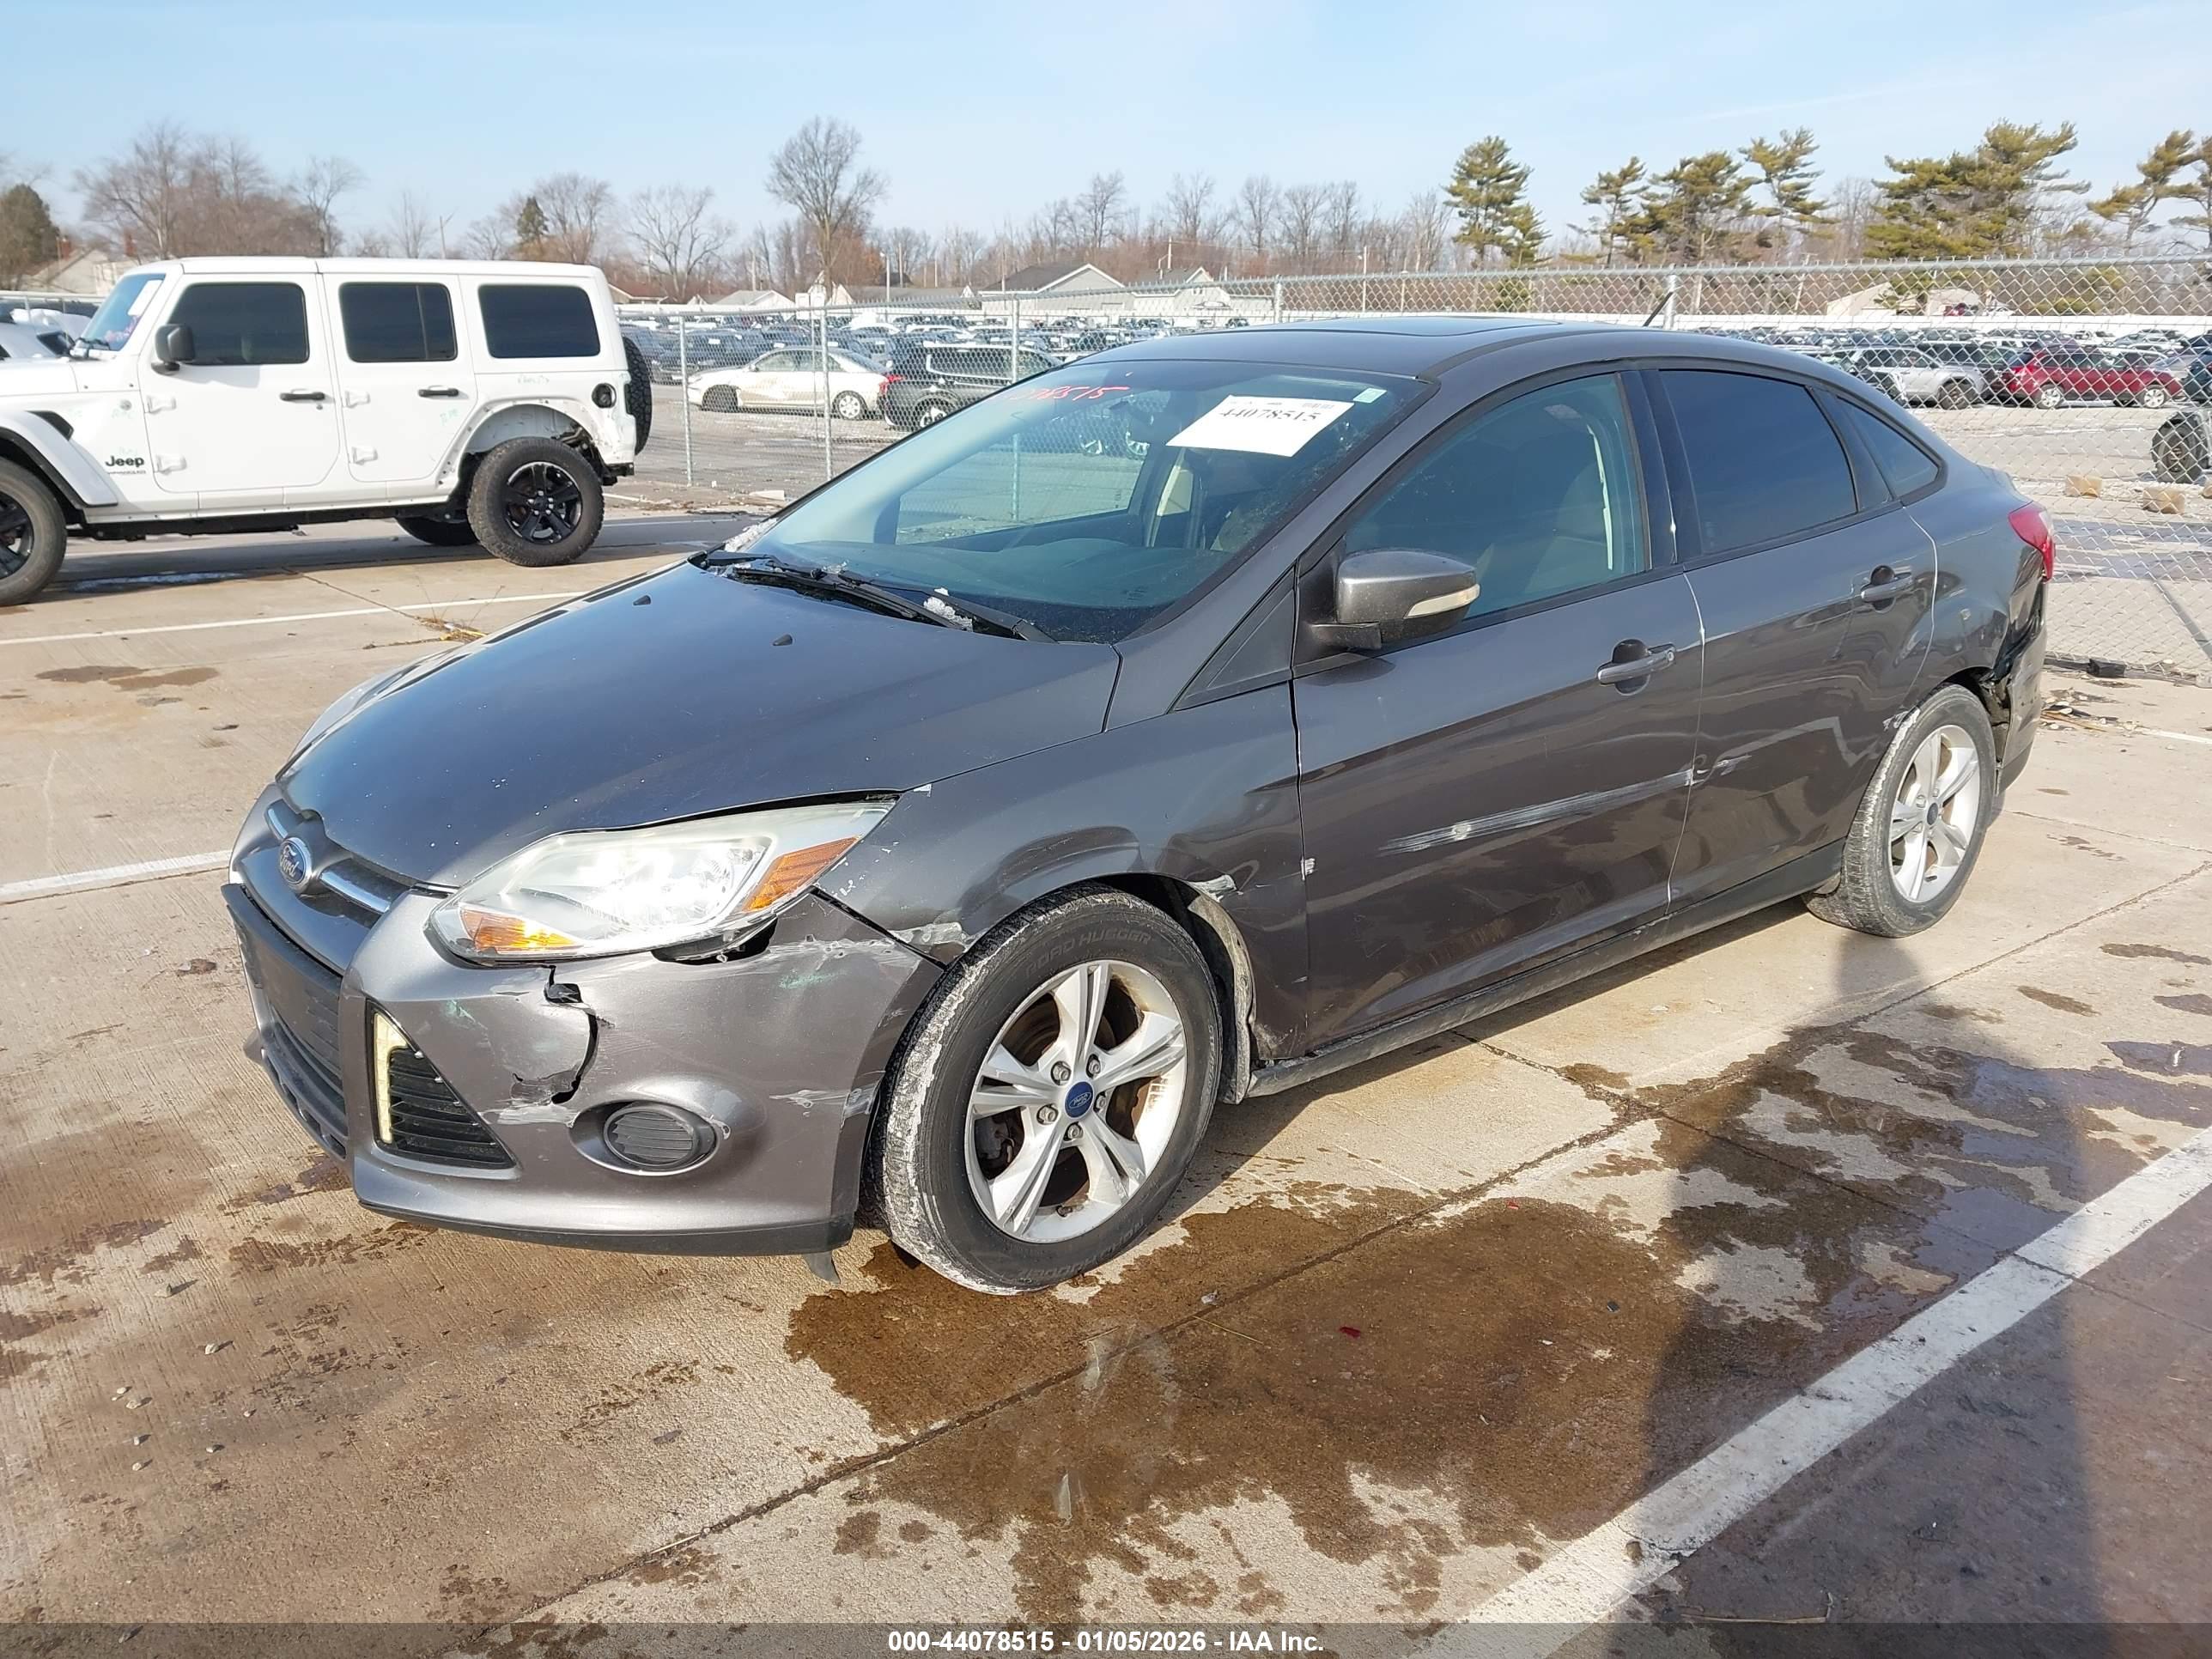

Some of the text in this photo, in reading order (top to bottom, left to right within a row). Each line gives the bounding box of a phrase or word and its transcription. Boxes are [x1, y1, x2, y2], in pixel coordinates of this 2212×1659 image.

[1219, 408, 1322, 422] 44078515
[105, 455, 144, 468] Jeep
[279, 844, 301, 878] Ford
